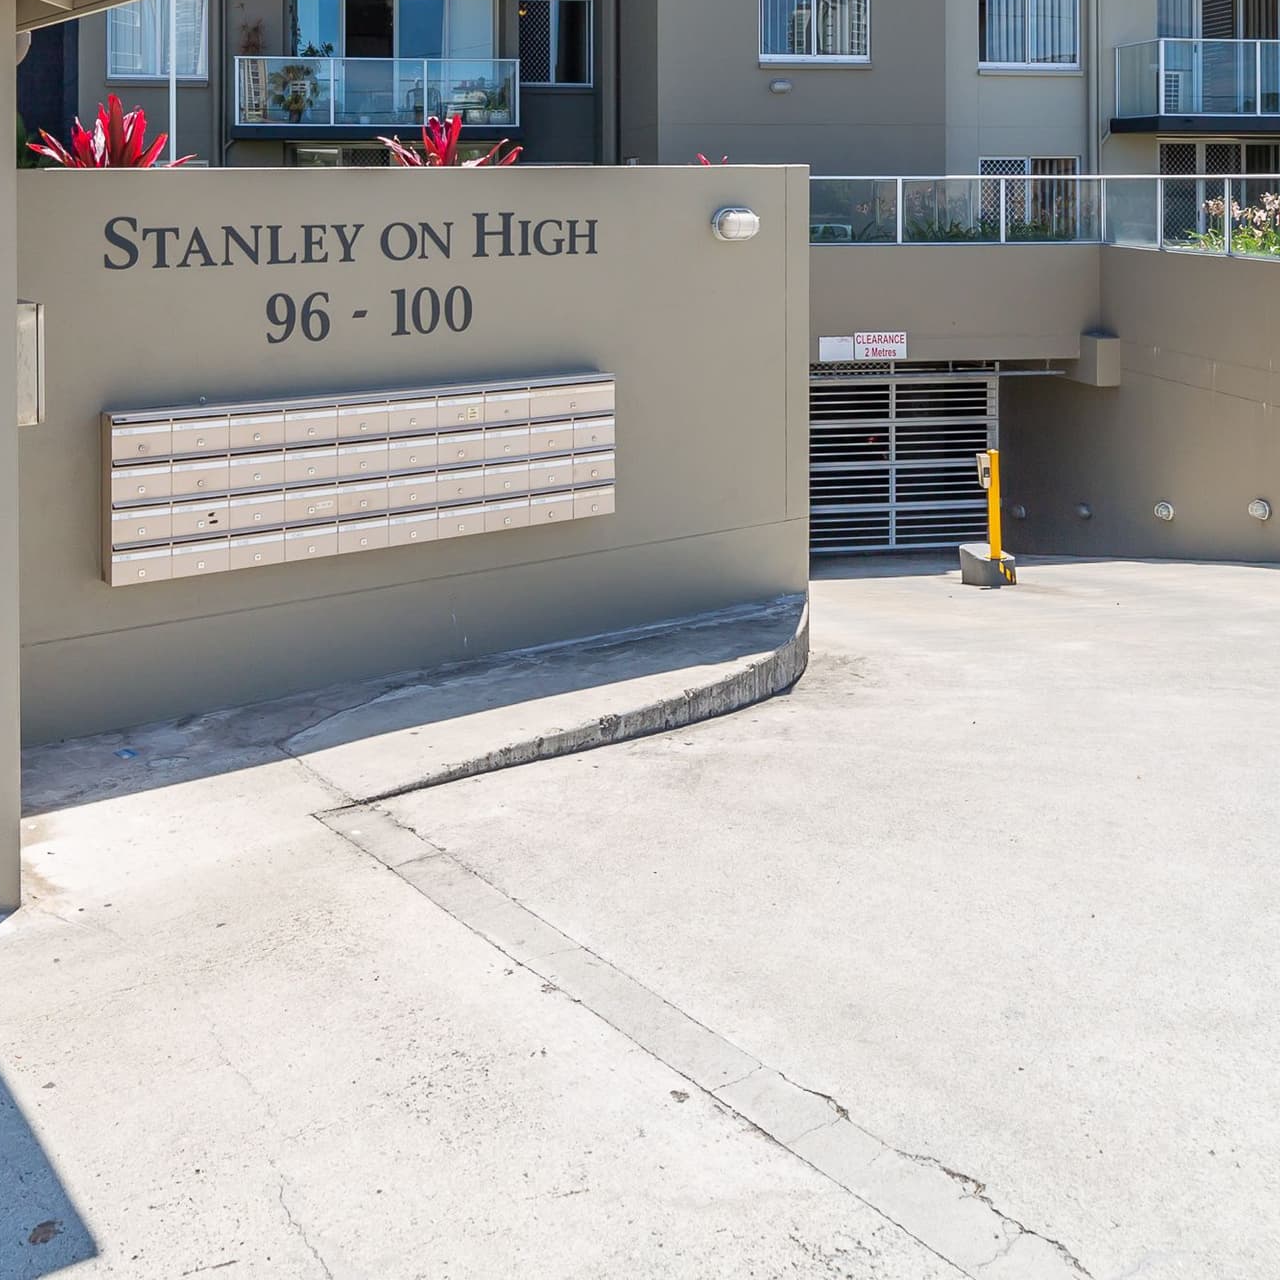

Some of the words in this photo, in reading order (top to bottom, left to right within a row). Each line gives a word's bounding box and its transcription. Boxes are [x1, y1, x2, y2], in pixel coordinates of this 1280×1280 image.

[103, 216, 365, 271] STANLEY
[379, 221, 455, 261] ON
[471, 211, 599, 258] HIGH
[265, 291, 331, 344] 96
[390, 285, 473, 337] 100
[855, 334, 905, 345] CLEARANCE
[864, 347, 870, 357] 2
[871, 347, 897, 357] Metres
